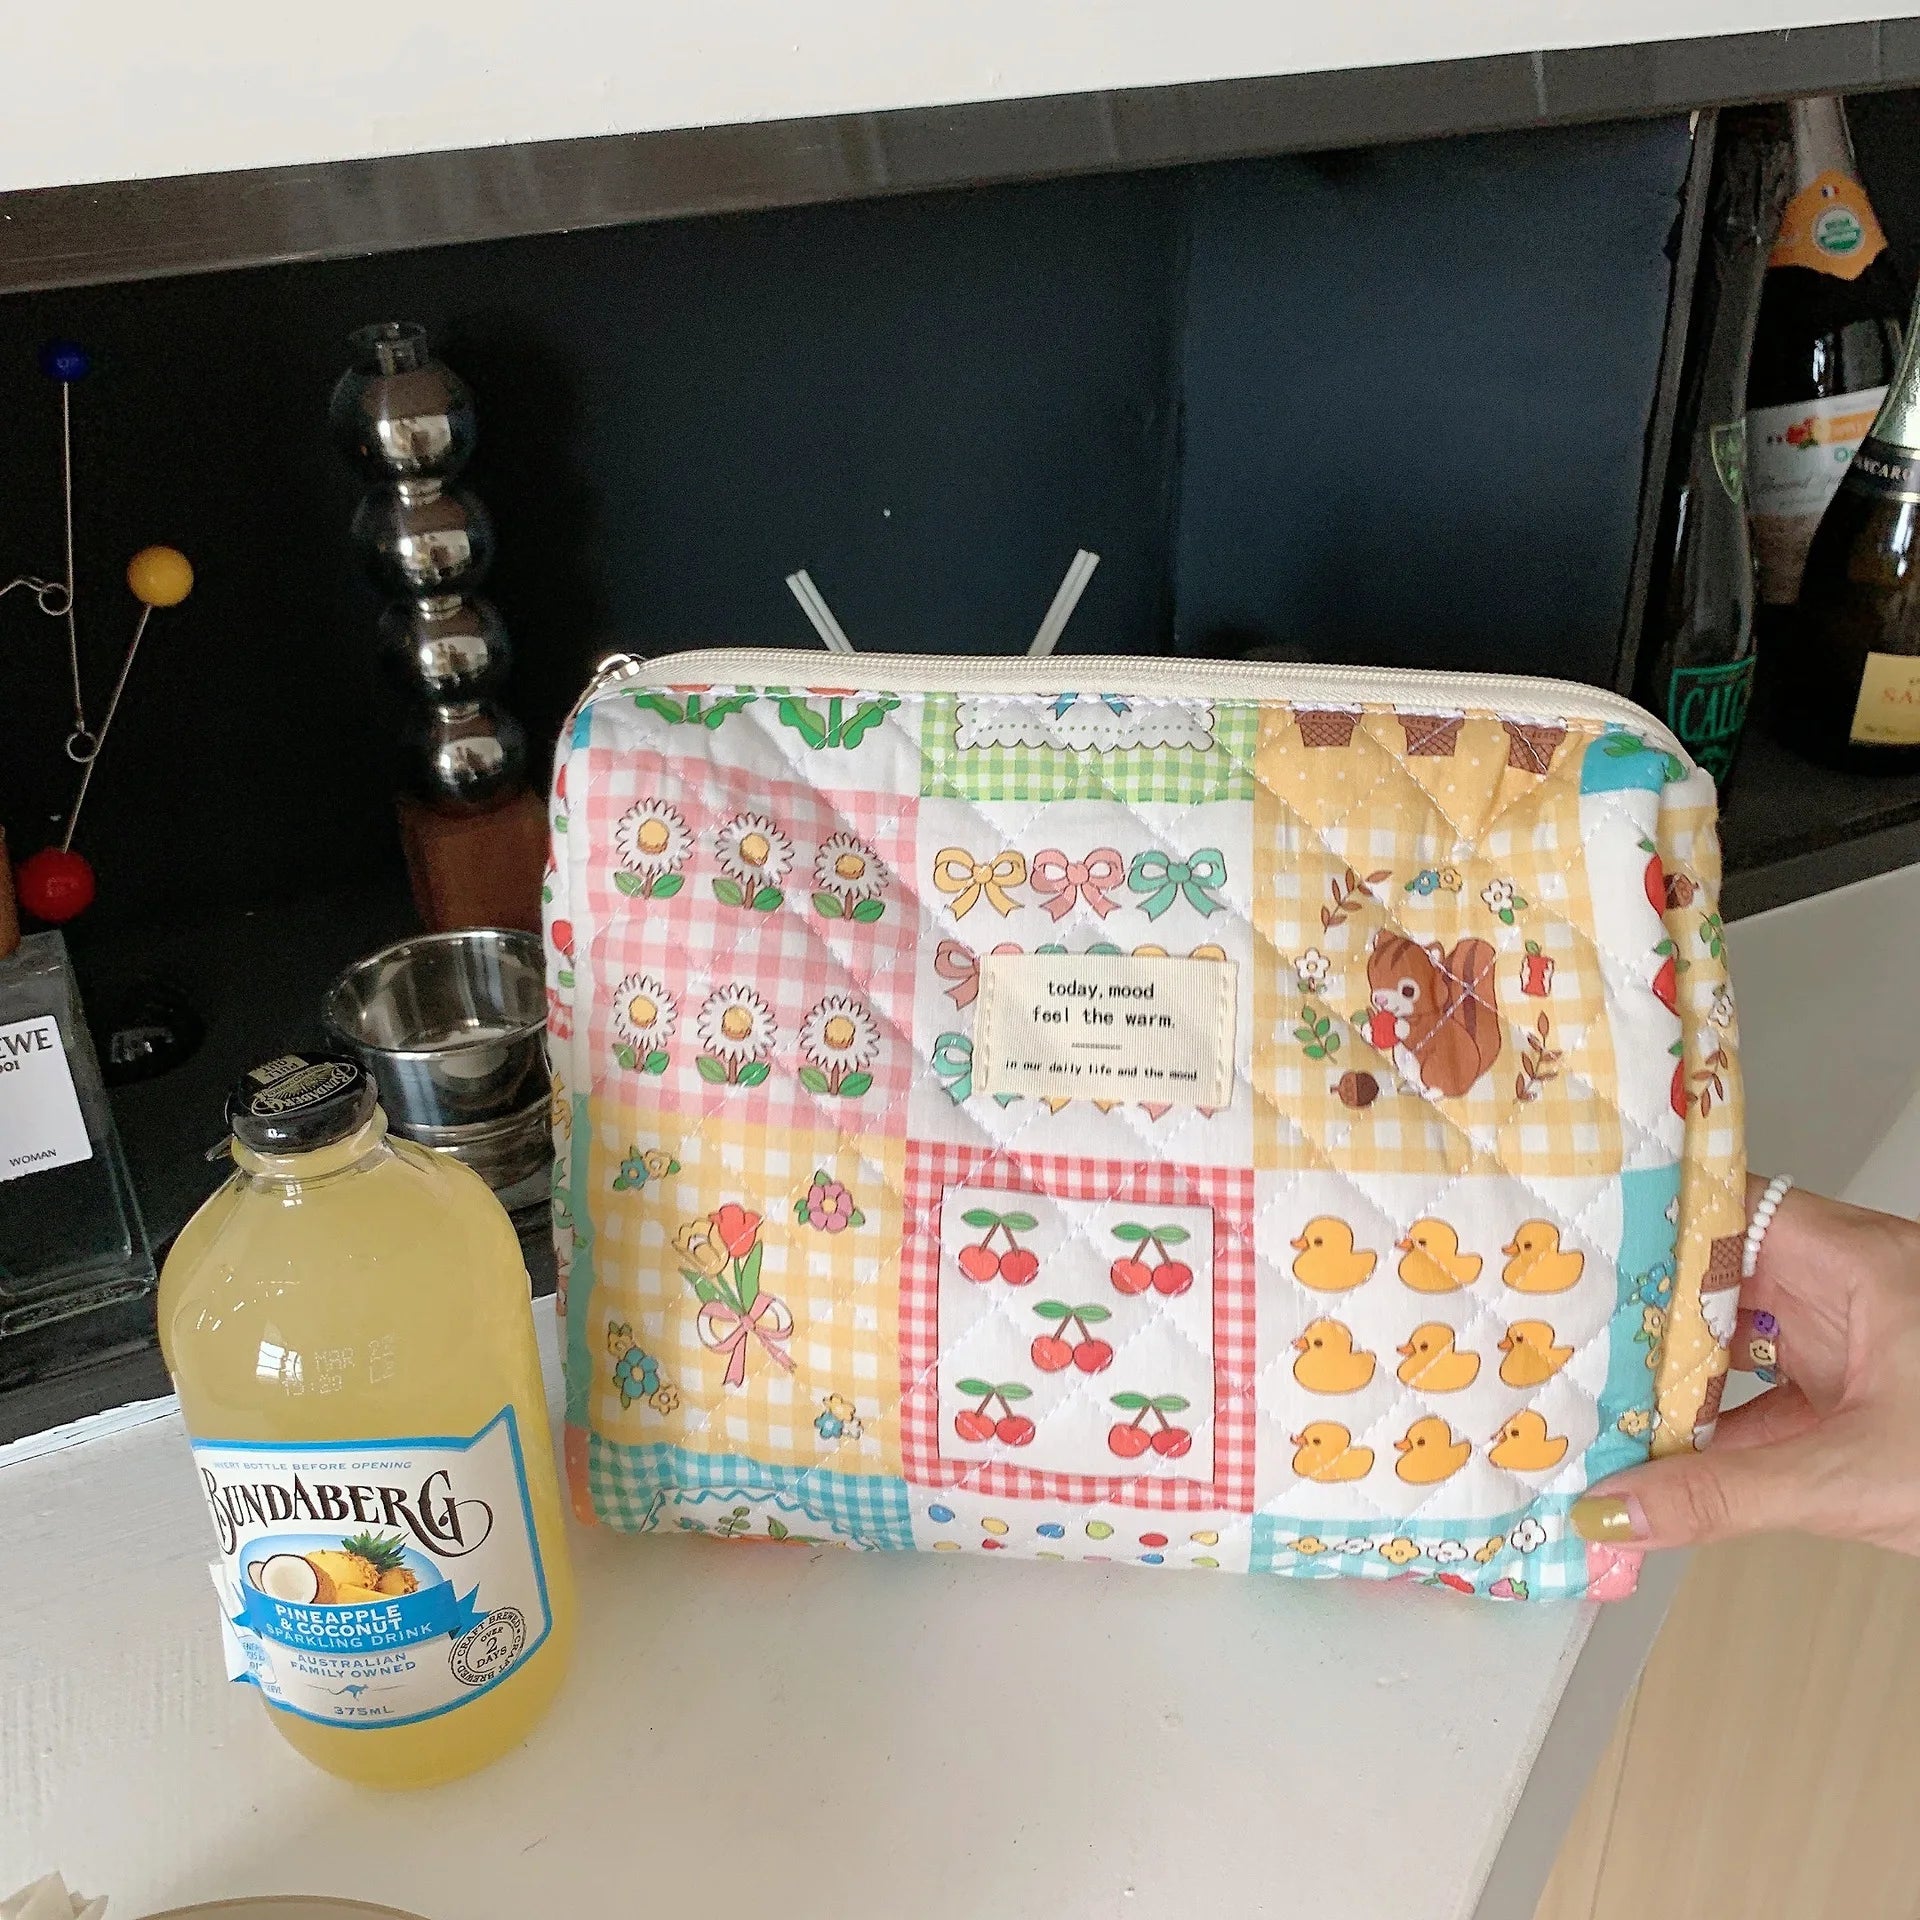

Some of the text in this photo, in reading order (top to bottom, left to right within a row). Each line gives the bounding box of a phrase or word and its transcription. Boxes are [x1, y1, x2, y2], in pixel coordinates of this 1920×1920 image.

[1033, 1004, 1069, 1023] feel
[1083, 1007, 1114, 1026] the
[1006, 1059, 1018, 1070] in
[1023, 1061, 1041, 1072] our
[1049, 1061, 1082, 1076] daily
[1089, 1064, 1112, 1075] life
[1118, 1066, 1138, 1078] and
[1144, 1067, 1164, 1079] the
[255, 1064, 351, 1112] BUNDABERG
[9, 1149, 57, 1167] WOMAN
[243, 1462, 288, 1471] BOTTLE
[293, 1463, 347, 1471] BEFORE
[351, 1461, 412, 1470] OPENING
[201, 1467, 494, 1557] BUNDABERG
[274, 1604, 401, 1624] PINEAPPLE
[266, 1622, 433, 1648] SPARKLING DRINK
[280, 1617, 402, 1637] & COCONUT
[457, 1611, 521, 1657] CRAFT BREWED
[480, 1626, 504, 1642] OVER
[486, 1637, 498, 1655] 2
[298, 1652, 407, 1668] AUSTRALIAN
[476, 1646, 507, 1668] DAYS
[290, 1660, 416, 1678] FAMILY OWNED
[457, 1665, 495, 1683] BREWED
